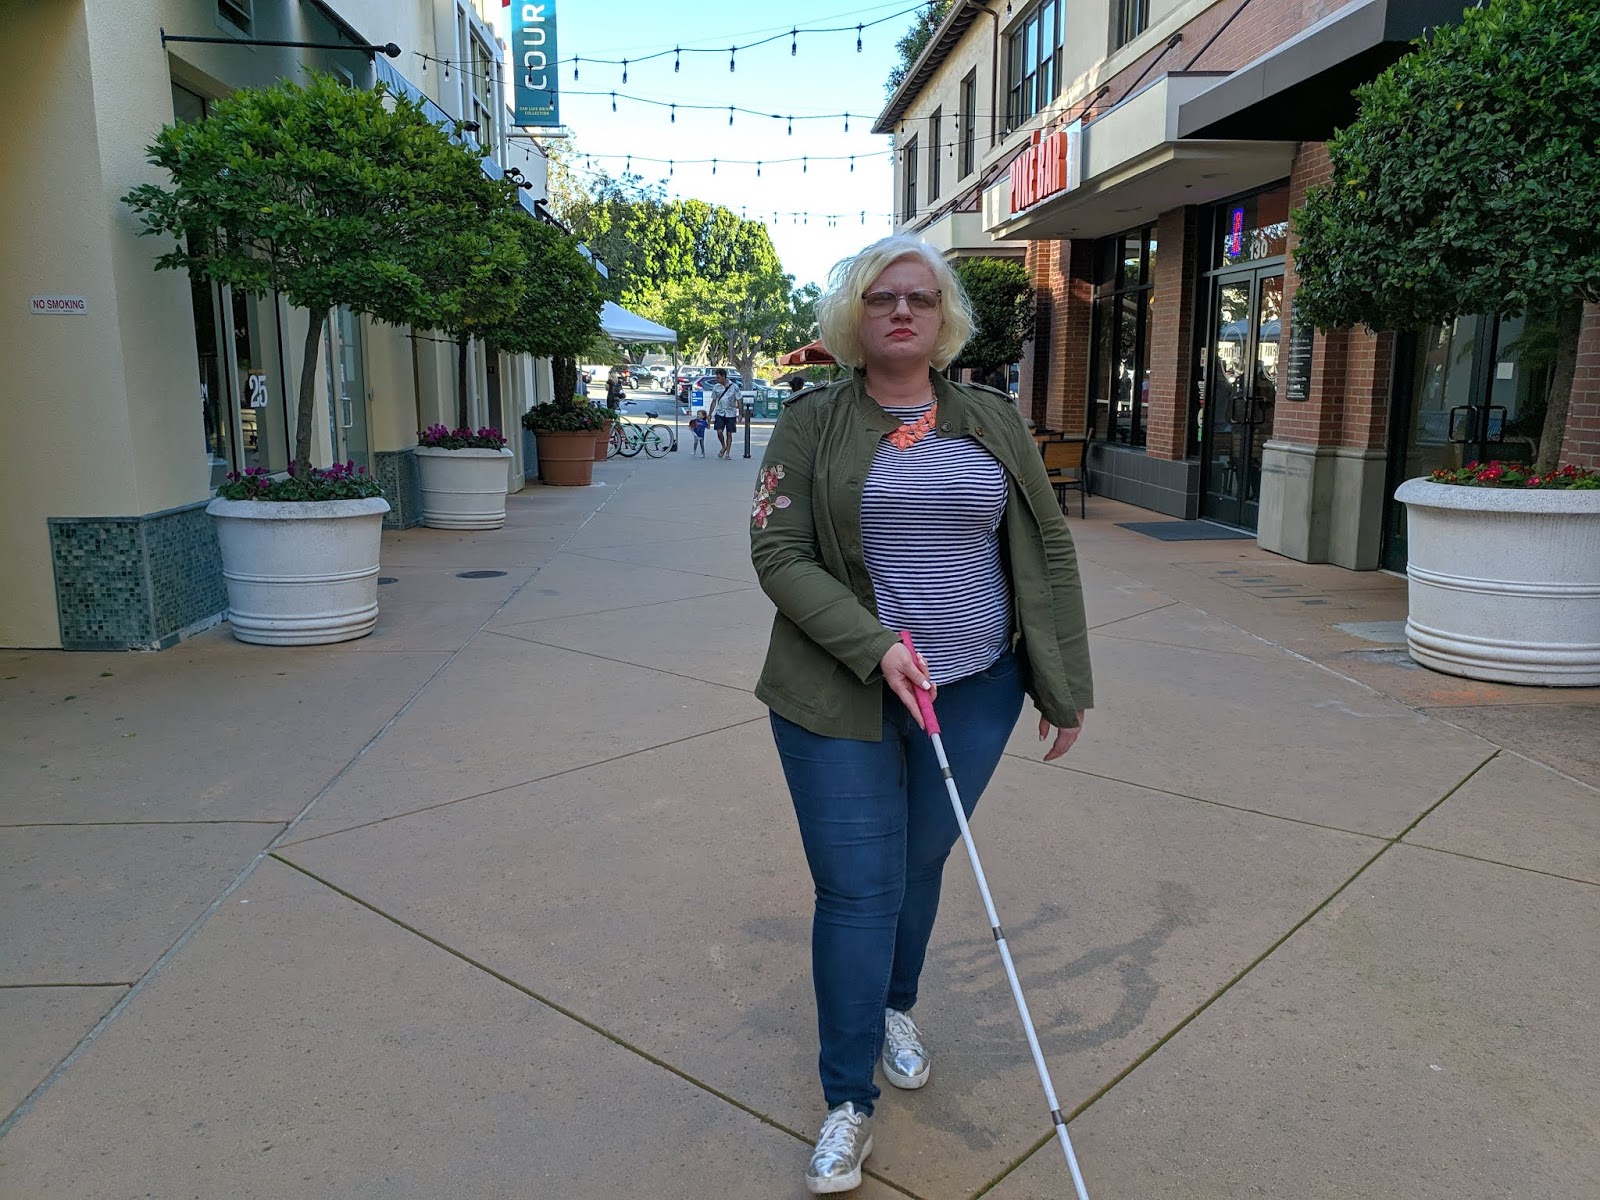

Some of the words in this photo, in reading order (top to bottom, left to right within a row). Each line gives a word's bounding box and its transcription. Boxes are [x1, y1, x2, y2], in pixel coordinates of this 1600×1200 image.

[522, 0, 547, 90] COUR
[1036, 131, 1067, 200] BAR
[1249, 238, 1268, 261] 130
[33, 299, 45, 309] NO
[46, 299, 85, 309] SMOKING
[248, 374, 268, 408] 25
